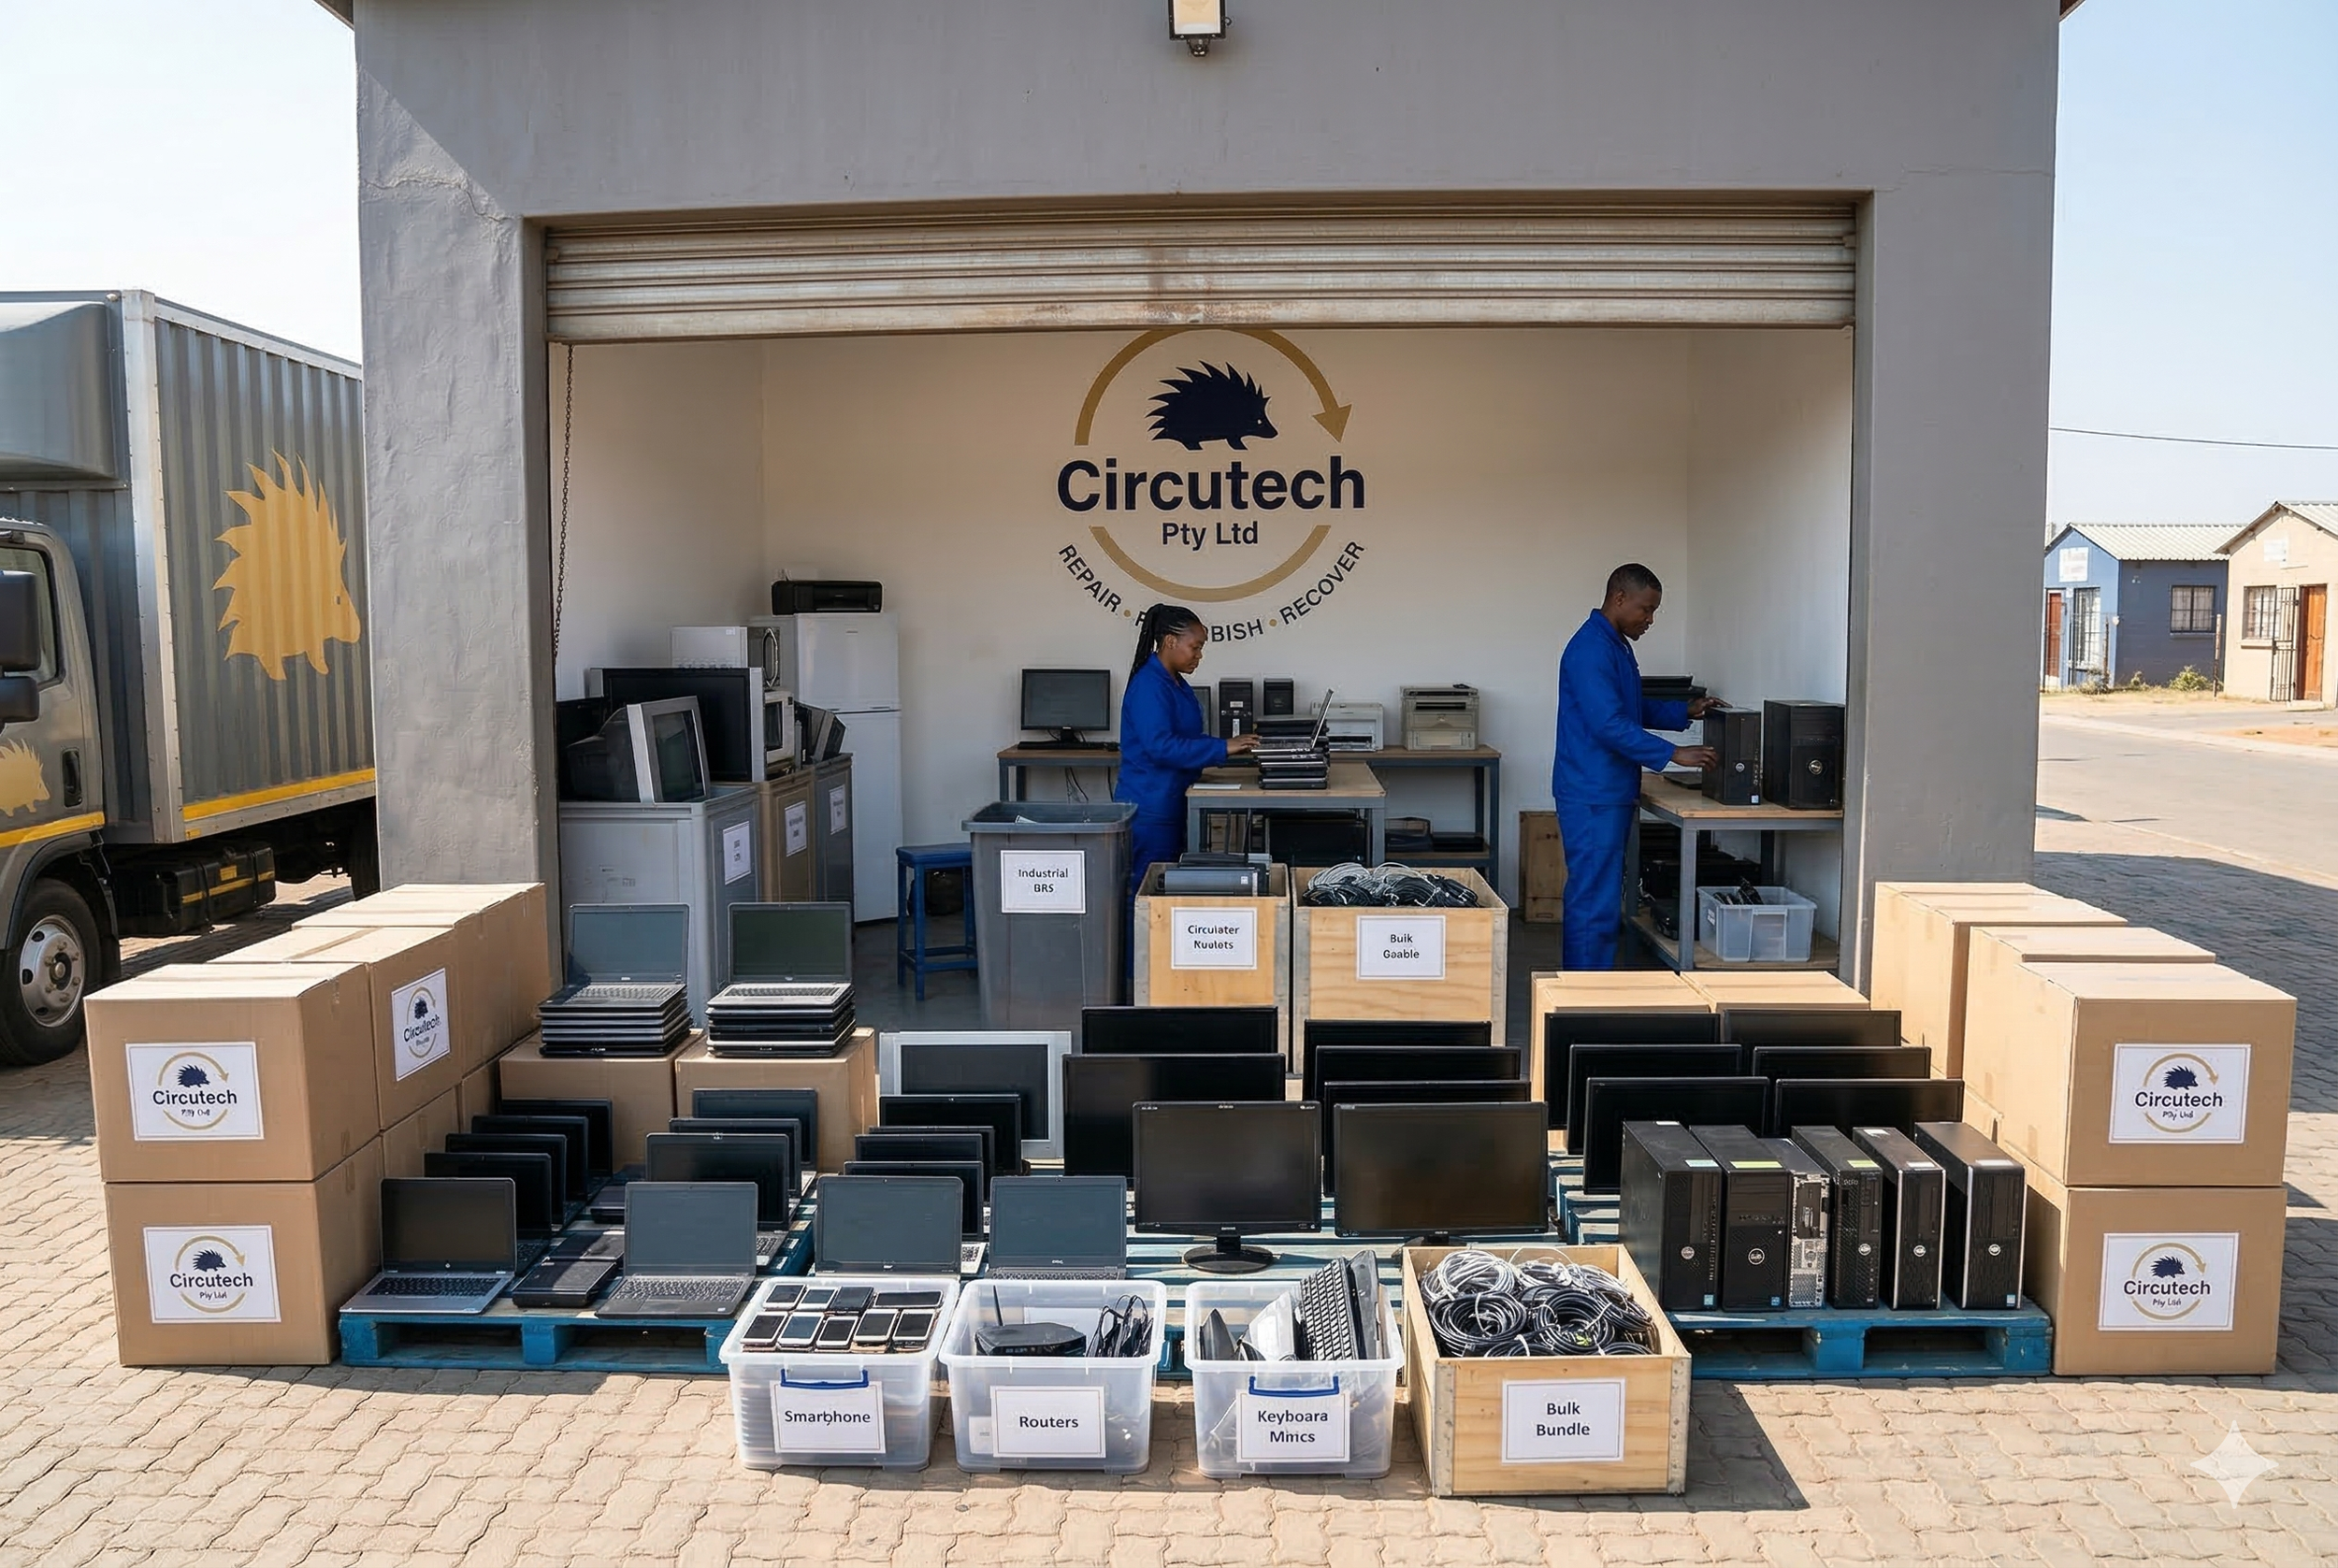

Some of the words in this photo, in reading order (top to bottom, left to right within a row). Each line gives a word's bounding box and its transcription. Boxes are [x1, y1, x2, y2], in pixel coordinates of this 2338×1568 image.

[1057, 455, 1365, 511] Circutech
[1162, 523, 1206, 551] Pty
[1216, 521, 1258, 544] Ltd
[1058, 544, 1122, 612] REPAIR
[1134, 610, 1263, 642] RBISH
[1278, 541, 1365, 626] RECOVER
[1018, 868, 1069, 878] Industrial
[1033, 884, 1054, 893] BRS
[152, 1089, 238, 1105] Circutech
[2135, 1091, 2223, 1107] Circutech
[170, 1273, 253, 1288] Circutech
[2124, 1280, 2211, 1295] Circutech
[1547, 1402, 1580, 1416] Bulk
[1019, 1416, 1079, 1429] Routers
[1258, 1409, 1328, 1425] Keyboara
[1537, 1422, 1591, 1436] Bundle
